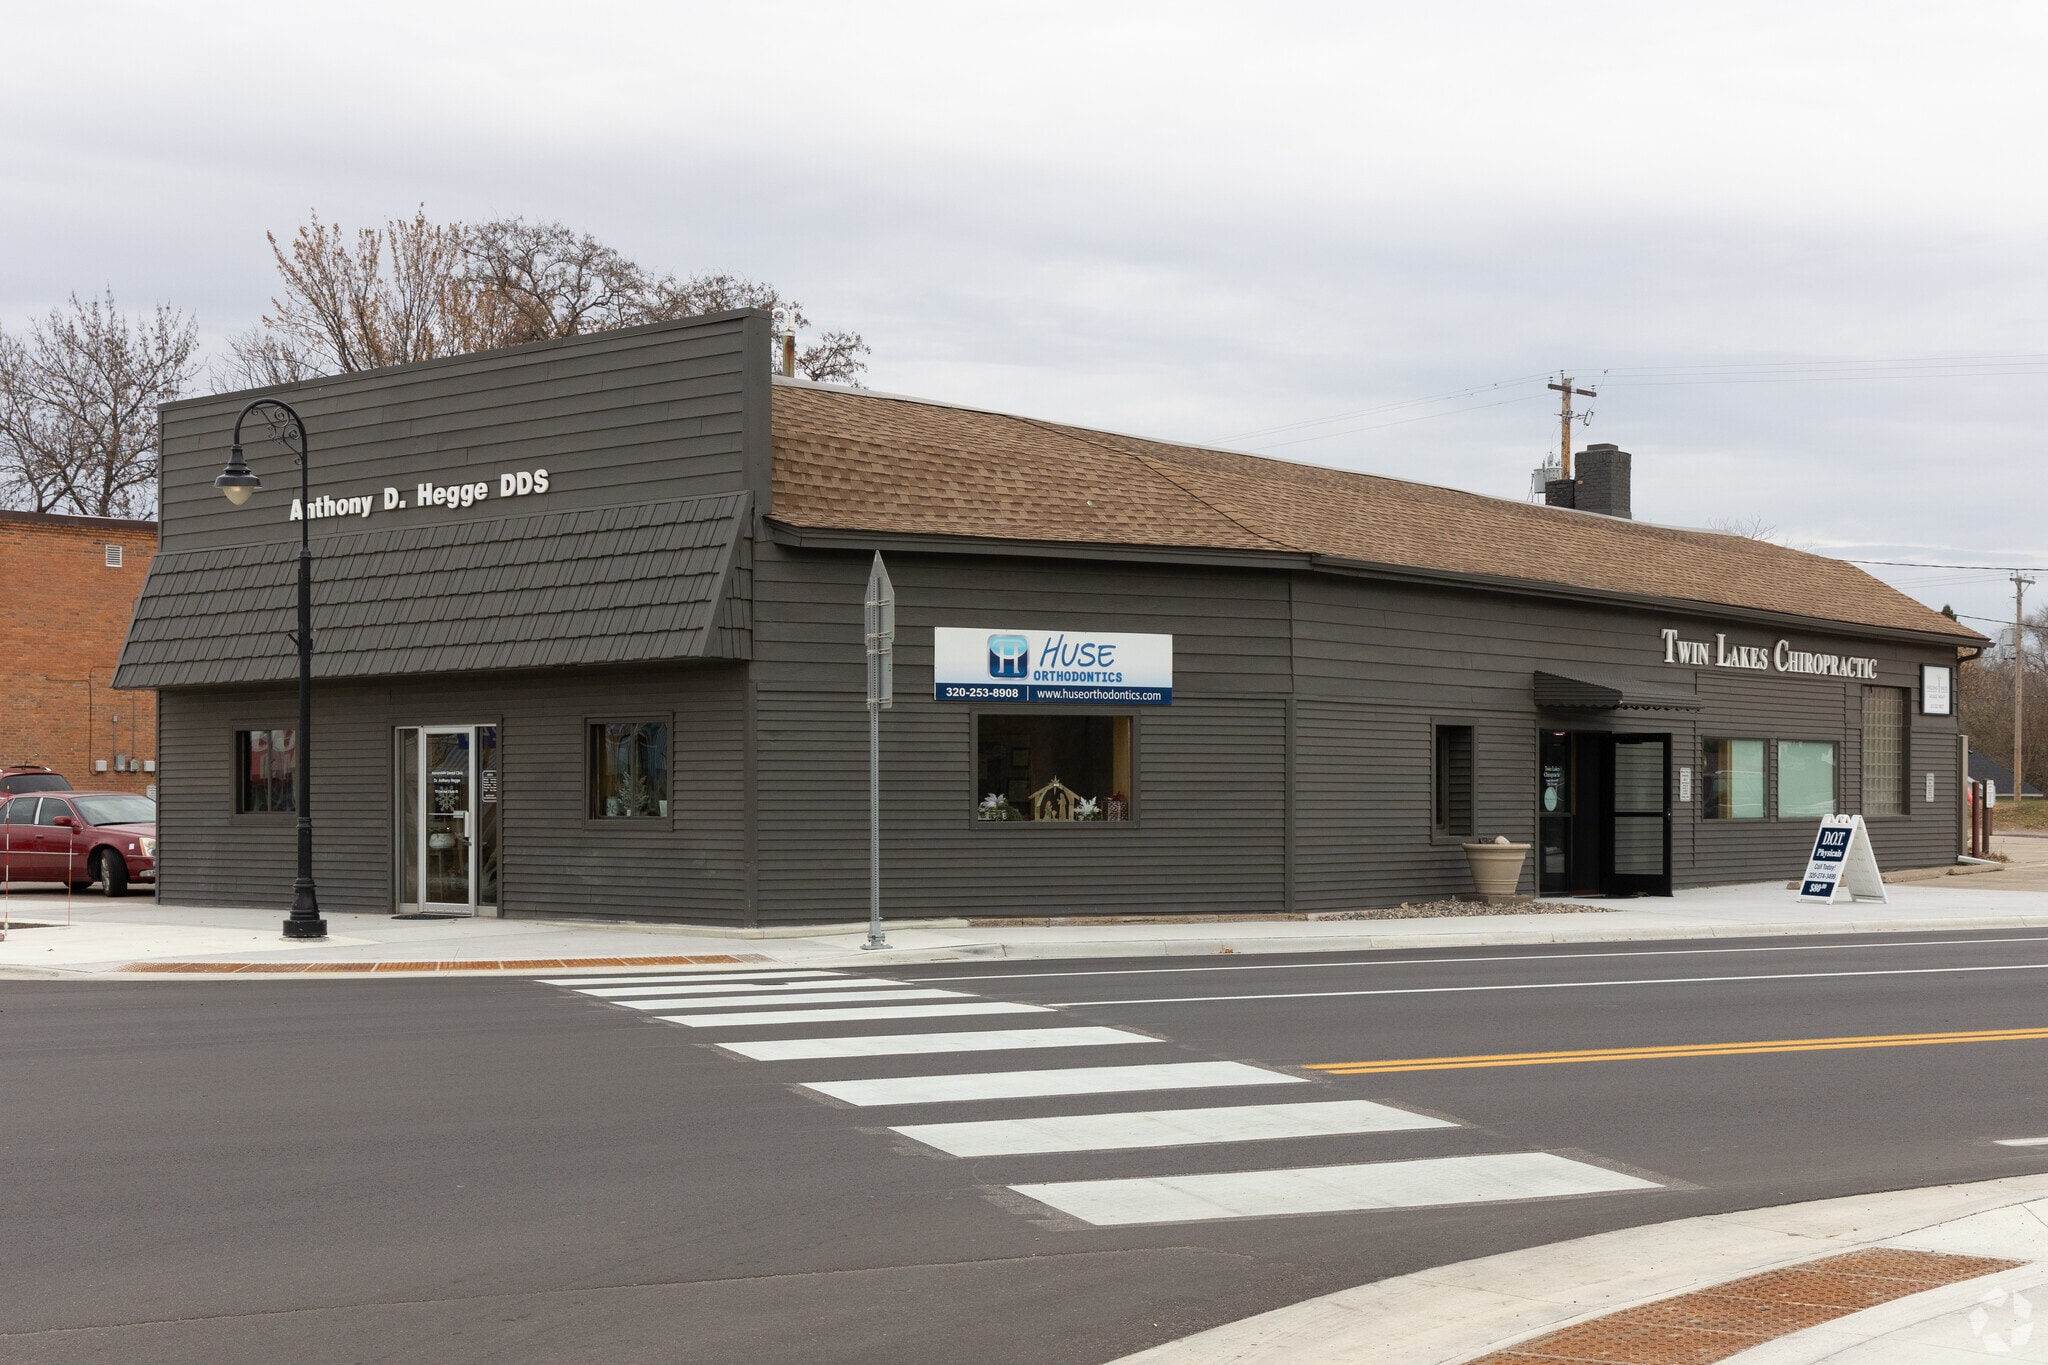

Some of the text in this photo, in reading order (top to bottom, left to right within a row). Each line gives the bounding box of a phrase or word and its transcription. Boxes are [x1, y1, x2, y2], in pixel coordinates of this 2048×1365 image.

[289, 468, 549, 521] Anthony D. Hegge DDS
[1039, 634, 1117, 668] HUSE
[1033, 670, 1123, 683] ORTHODONTICS
[946, 687, 1019, 698] 320-253-8908
[1037, 688, 1161, 701] www.huseorthodontics.com
[1816, 848, 1843, 858] Physicals
